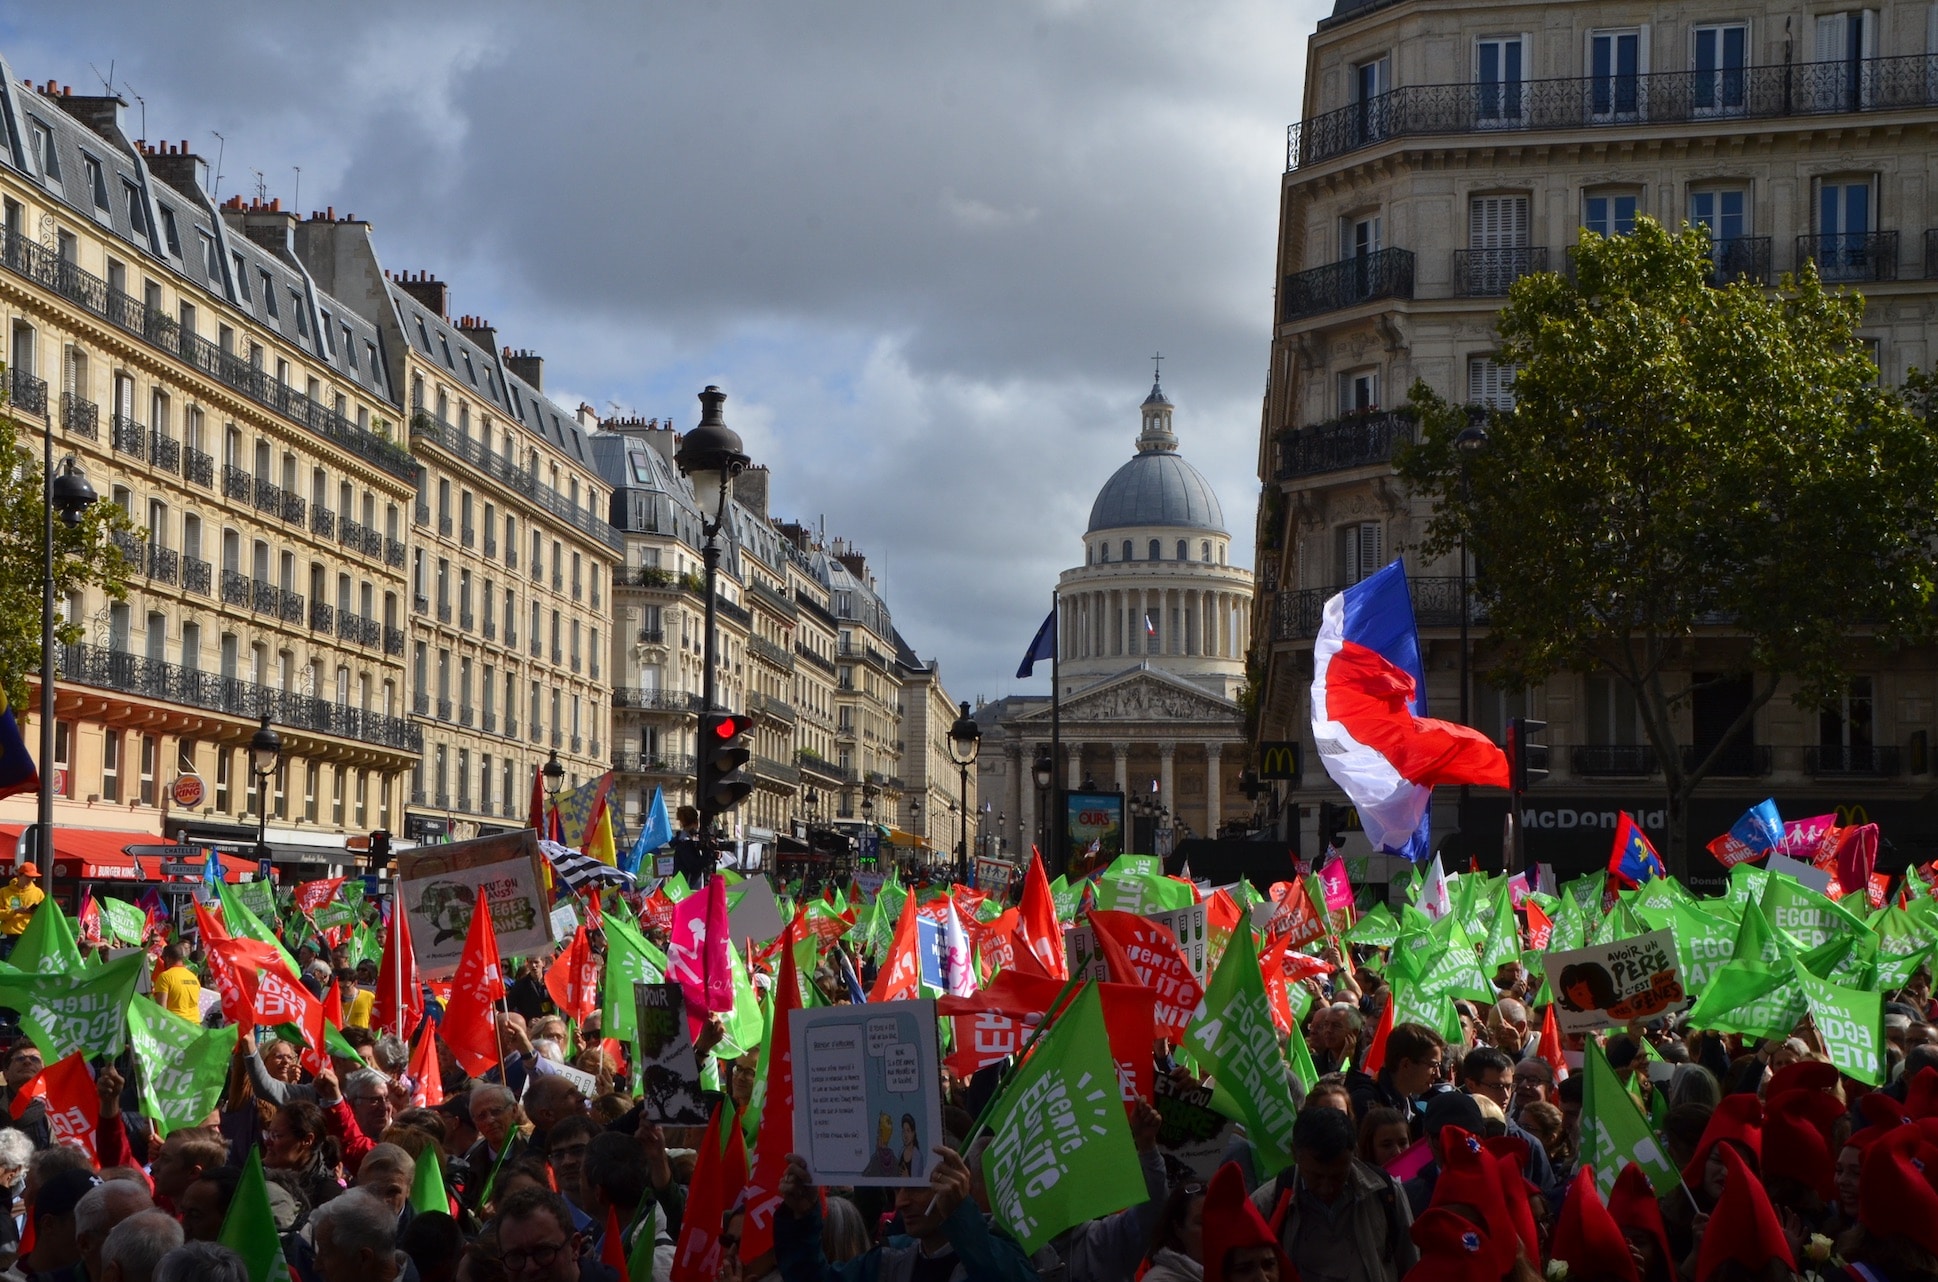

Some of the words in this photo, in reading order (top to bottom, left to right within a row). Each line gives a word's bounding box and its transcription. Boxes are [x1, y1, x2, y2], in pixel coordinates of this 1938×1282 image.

[175, 782, 200, 791] BURGER
[175, 788, 200, 799] KING
[1079, 812, 1110, 826] OURS
[1521, 808, 1668, 829] McDonld'
[98, 866, 120, 878] BURGER
[1127, 944, 1182, 975] iBeRTé
[1607, 945, 1643, 962] AVOIR
[1644, 940, 1659, 953] UN
[1611, 950, 1670, 988] PÈRE
[644, 987, 670, 1007] POUR
[1625, 980, 1649, 995] C'EST
[1178, 1088, 1211, 1107] POU
